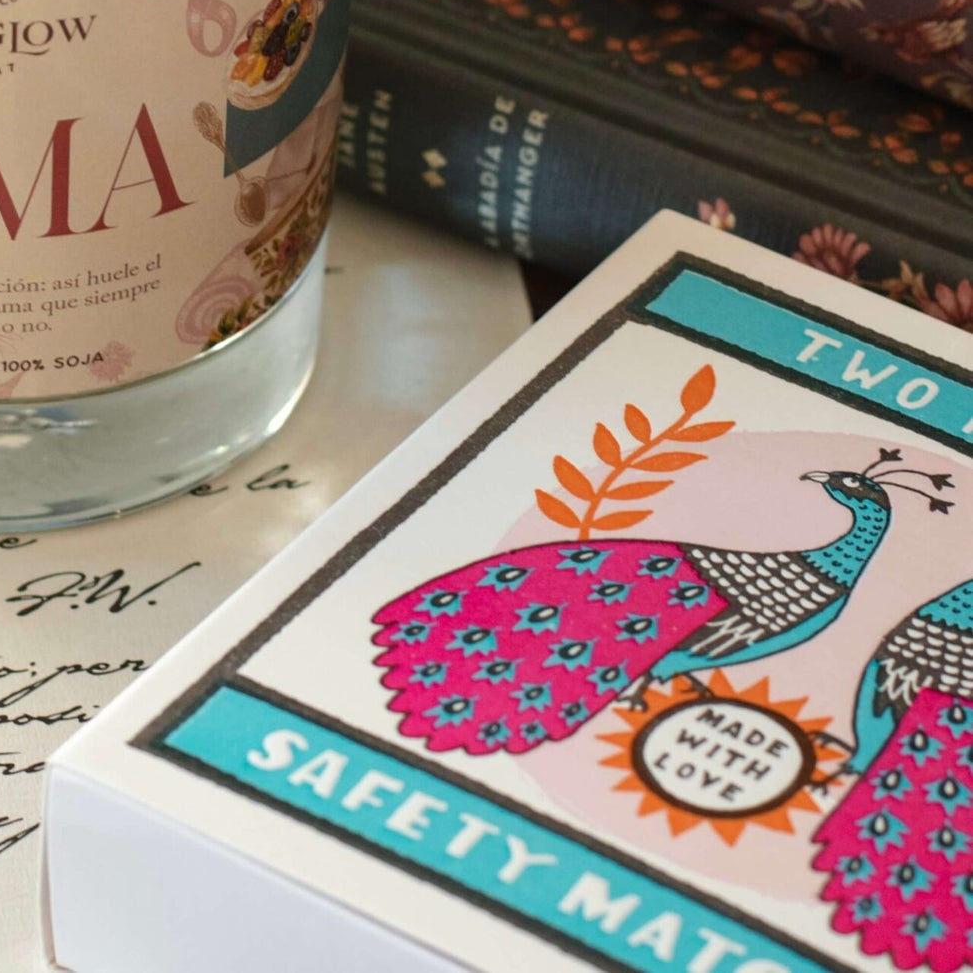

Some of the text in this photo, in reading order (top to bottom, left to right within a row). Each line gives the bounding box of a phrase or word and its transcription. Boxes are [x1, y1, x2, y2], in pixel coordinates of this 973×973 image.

[337, 103, 359, 169] JANE
[488, 95, 517, 135] DE
[366, 89, 393, 195] AUSTEN
[40, 297, 78, 316] que
[83, 276, 162, 310] siempre
[51, 273, 82, 292] así
[86, 263, 140, 288] huele
[144, 252, 163, 272] el
[1, 321, 15, 335] o
[20, 318, 53, 335] no.
[1, 349, 105, 373] 100% SOJA
[795, 327, 941, 411] TWO
[676, 728, 772, 782] WITH
[695, 708, 790, 759] MADE
[653, 752, 744, 803] LOVE
[246, 729, 559, 885] SAFETY
